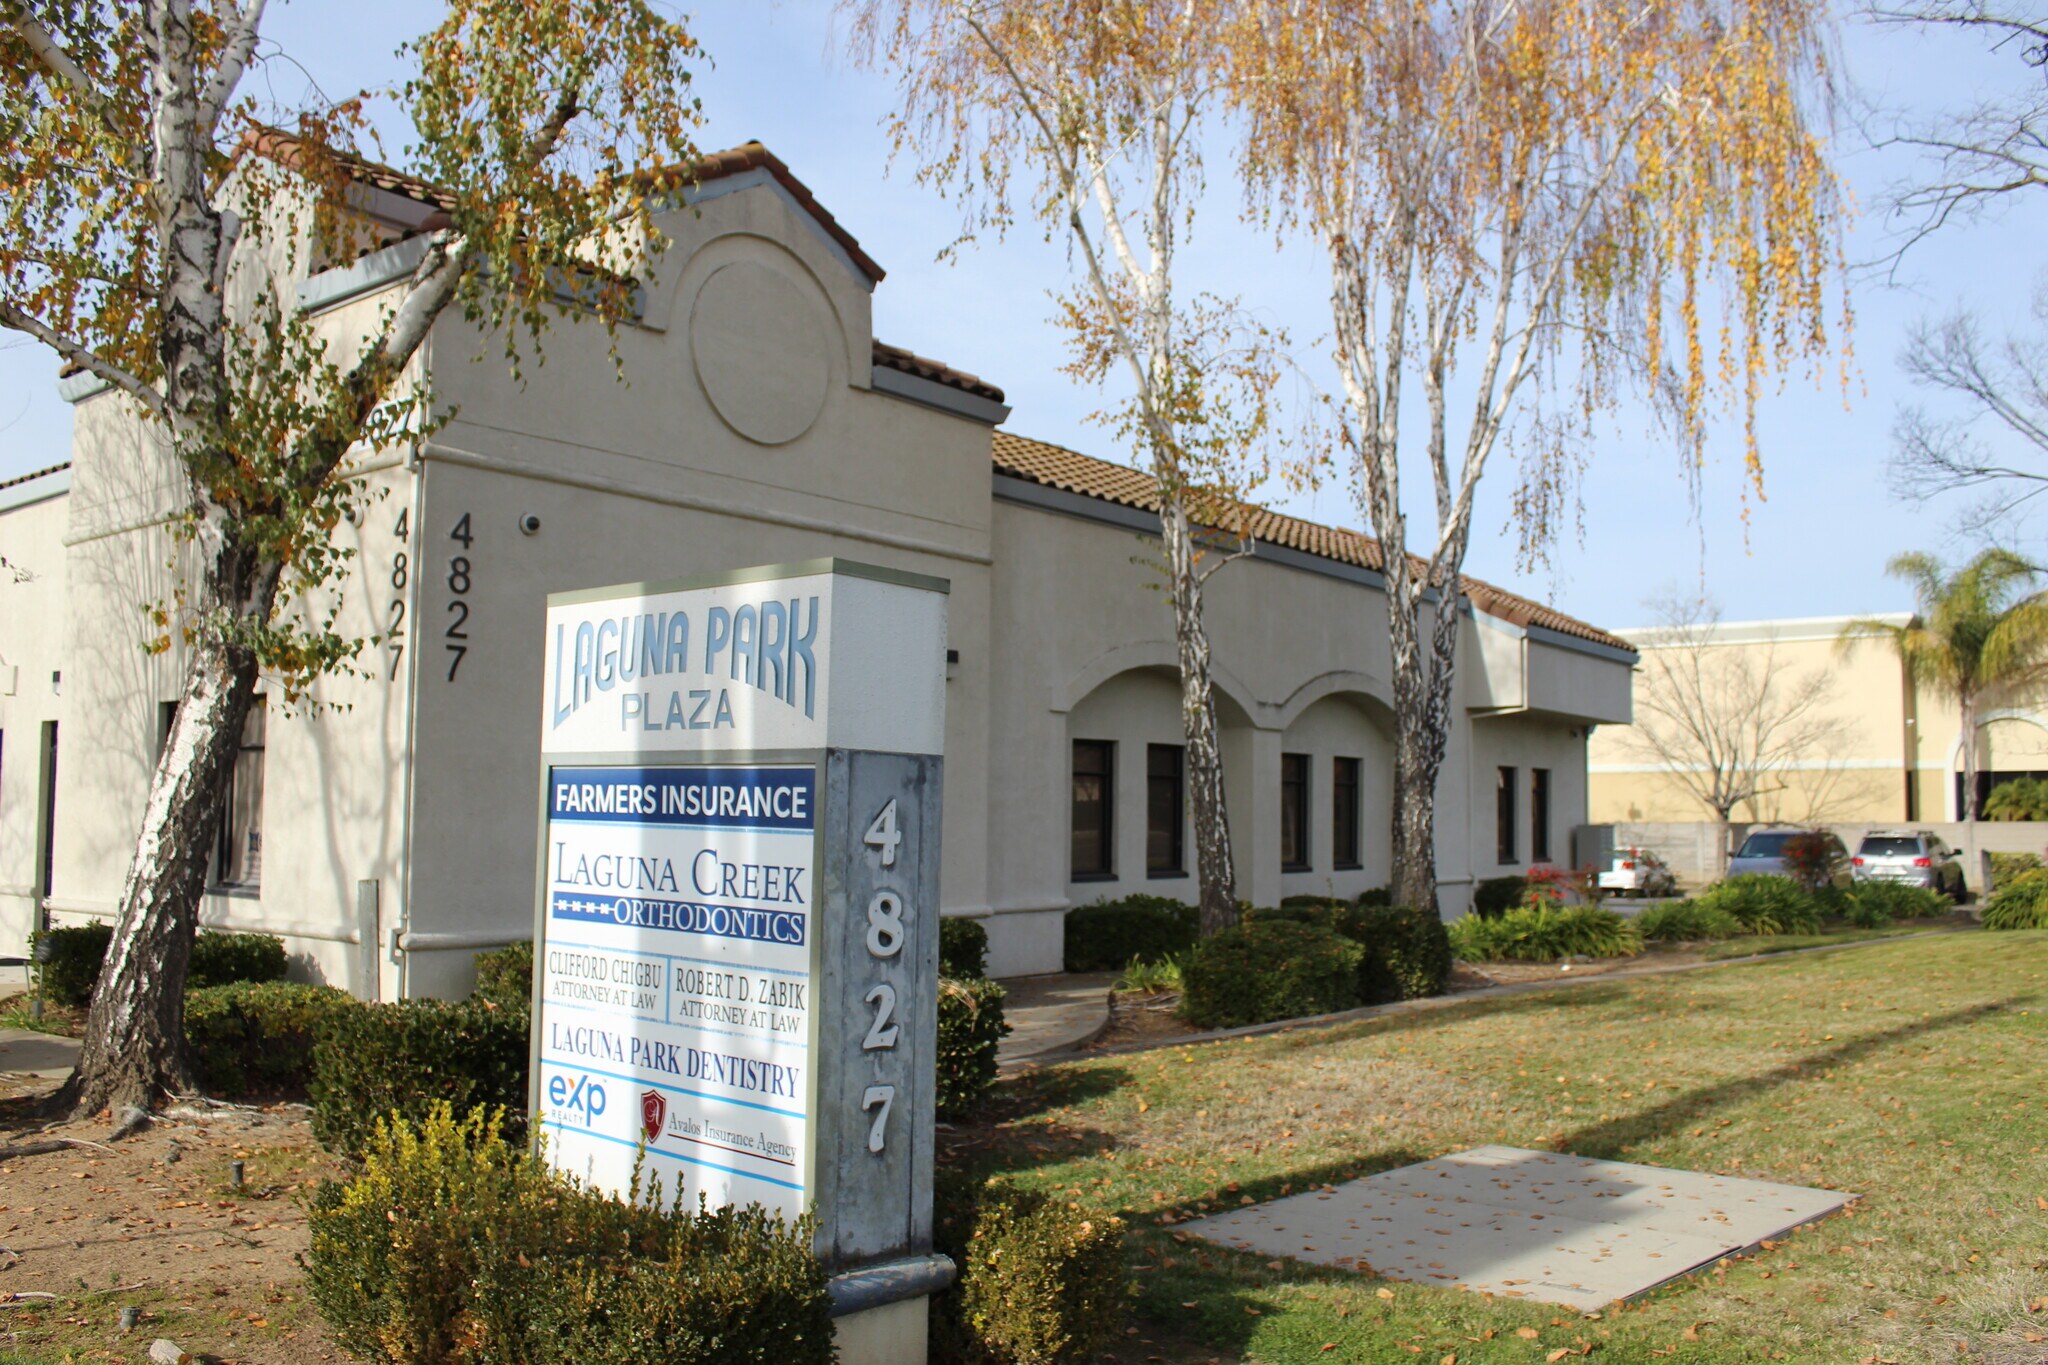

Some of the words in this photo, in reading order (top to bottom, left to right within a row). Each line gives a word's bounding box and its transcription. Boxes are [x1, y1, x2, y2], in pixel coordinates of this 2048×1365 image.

[388, 507, 408, 682] 4827
[446, 512, 473, 682] 4827
[553, 611, 690, 731] LAGUNA
[705, 596, 819, 721] PARK
[621, 688, 735, 731] PLAZA
[556, 784, 656, 814] FARMERS
[661, 785, 807, 819] INSURANCE
[554, 842, 679, 893] LAGUNA
[692, 848, 806, 904] CREEK
[613, 898, 803, 943] ORTHODONTICS
[549, 951, 607, 981] CLIFFORD
[611, 959, 662, 989] CHIGBU
[676, 967, 734, 999] ROBERT
[738, 975, 754, 1003] D.
[758, 978, 806, 1011] ZABIK
[863, 798, 904, 1153] 4827
[552, 980, 610, 1004] ATTORNEY
[612, 989, 627, 1006] AT
[630, 991, 656, 1010] LAW
[680, 1000, 747, 1025] ATTORNEY
[749, 1010, 766, 1028] AT
[771, 1012, 800, 1034] LAW
[552, 1022, 624, 1063] LAGUNA
[629, 1036, 681, 1075] PARK
[687, 1047, 799, 1098] DENTISTRY
[551, 1109, 584, 1123] REALTY
[669, 1112, 701, 1135] Avalos
[704, 1119, 754, 1148] Insurance
[756, 1131, 797, 1163] Agency
